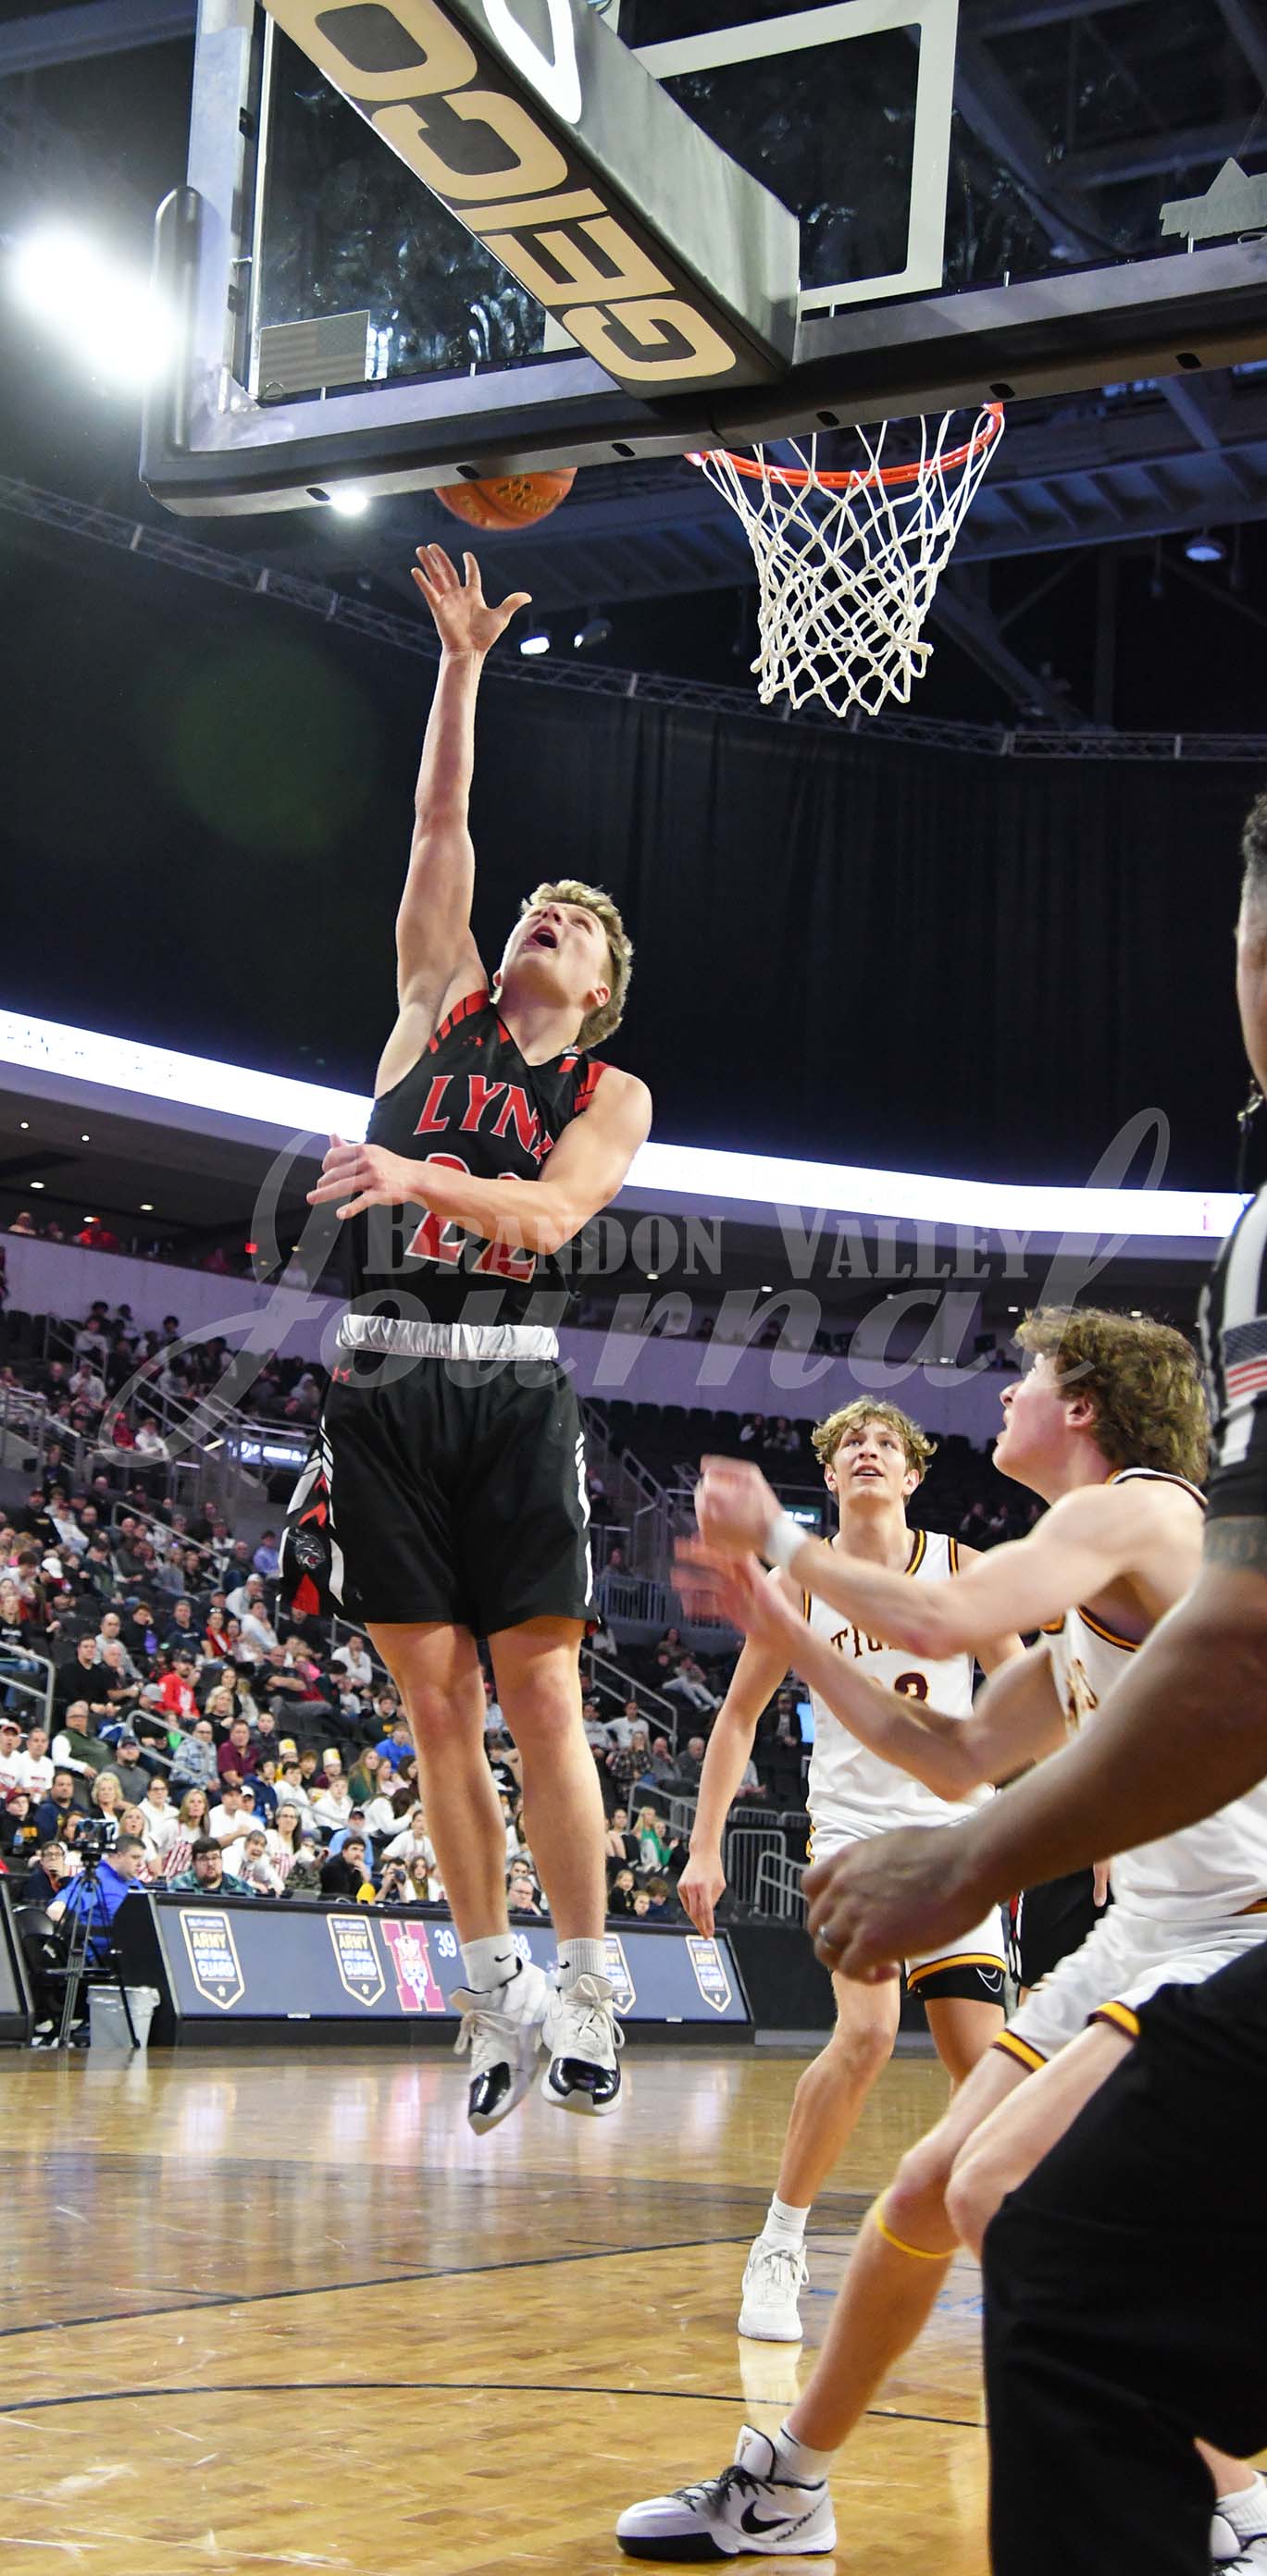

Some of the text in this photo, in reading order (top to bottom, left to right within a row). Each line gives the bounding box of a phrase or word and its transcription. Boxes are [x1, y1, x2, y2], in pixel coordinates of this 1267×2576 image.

[268, 0, 737, 382] GEICO
[193, 1931, 226, 1949] ARMY
[339, 1934, 368, 1950] ARMY
[434, 1929, 457, 1958] 39
